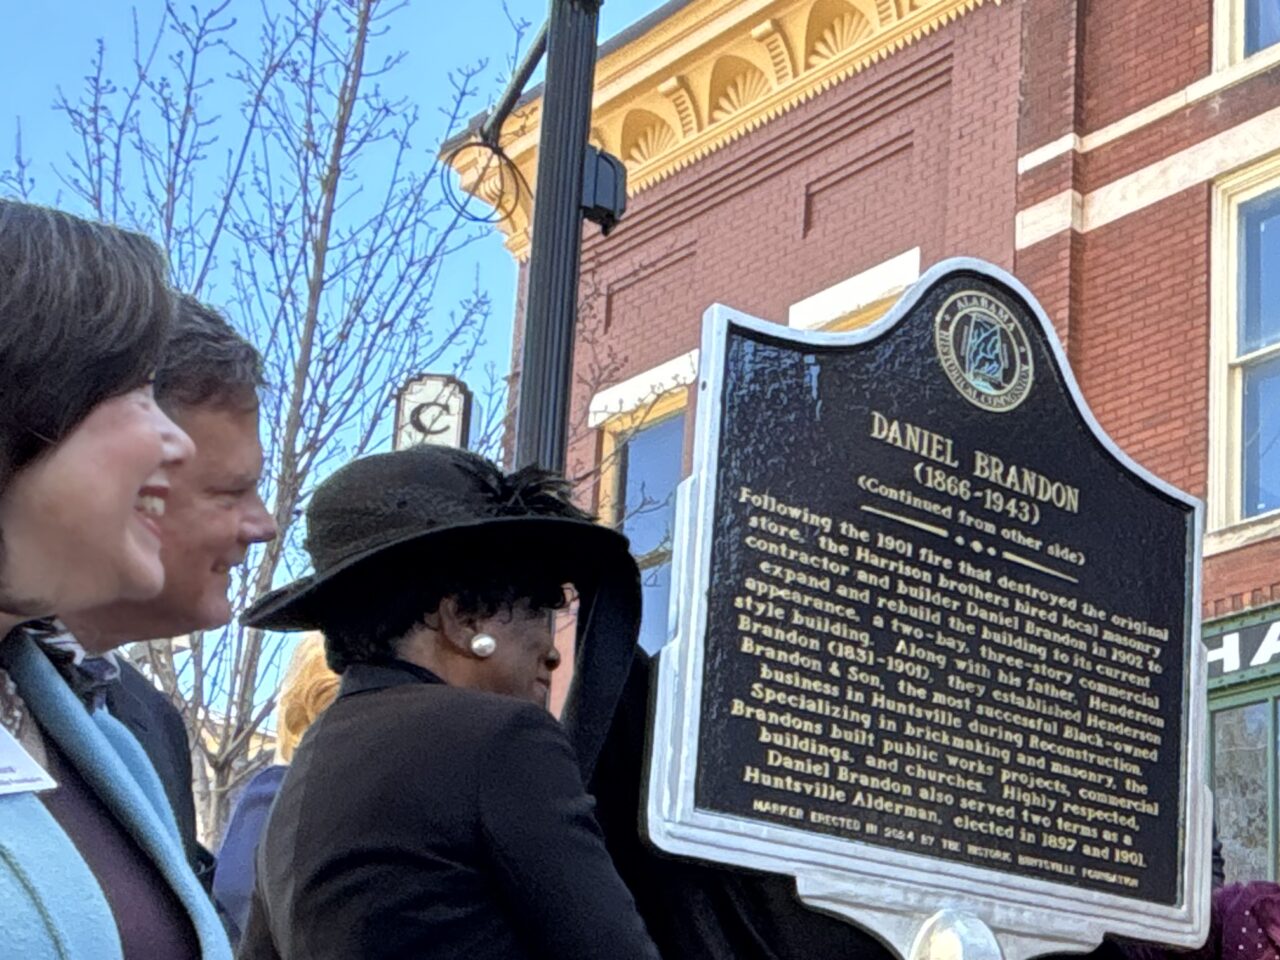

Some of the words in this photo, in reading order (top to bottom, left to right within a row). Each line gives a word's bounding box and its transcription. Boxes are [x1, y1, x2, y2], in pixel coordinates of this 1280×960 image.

[956, 296, 1015, 332] ALABAMA
[410, 402, 450, 435] C
[870, 410, 958, 467] DANIEL
[973, 450, 1078, 512] BRANDON
[857, 474, 952, 519] (Continued
[958, 509, 996, 534] from
[1000, 528, 1042, 550] other
[1047, 543, 1085, 565] side)
[913, 462, 1039, 524] (1866-1943)
[738, 486, 832, 532] Following
[839, 520, 869, 542] the
[876, 532, 912, 556] 1901
[919, 547, 952, 569] fire
[958, 560, 991, 582] that
[997, 575, 1077, 610] destroyed
[1081, 602, 1106, 620] the
[1110, 614, 1168, 641] original
[744, 535, 849, 575] contractor
[856, 569, 889, 589] and
[896, 579, 960, 610] builder
[966, 600, 1018, 629] Daniel
[1024, 619, 1086, 651] Brandon
[1091, 641, 1106, 657] in
[1111, 647, 1142, 668] 1902
[1147, 660, 1161, 673] to
[818, 536, 849, 556] the
[855, 545, 931, 583] Harrison
[937, 572, 1009, 608] brothers
[1014, 598, 1057, 623] hired
[1062, 613, 1098, 636] local
[1101, 629, 1160, 658] masonry
[733, 595, 784, 619] style
[895, 639, 946, 669] Along
[954, 658, 990, 678] with
[997, 668, 1021, 687] his
[1088, 694, 1164, 727] Henderson
[758, 560, 830, 592] expand
[835, 584, 869, 603] and
[876, 596, 940, 624] rebuild
[948, 615, 975, 634] the
[981, 625, 1047, 660] building
[1052, 648, 1069, 663] to
[1073, 653, 1092, 670] its
[1095, 663, 1150, 687] current
[872, 615, 883, 627] a
[979, 644, 1072, 684] three-story
[1078, 677, 1159, 709] commercial
[737, 614, 820, 650] Brandon
[947, 674, 985, 696] they
[991, 689, 1081, 722] established
[1086, 713, 1161, 744] Henderson
[740, 636, 822, 672] Brandon
[828, 661, 840, 677] &
[897, 679, 927, 699] the
[931, 691, 970, 710] most
[975, 704, 1057, 734] successful
[1062, 724, 1157, 761] Black-owned
[759, 663, 839, 696] business
[845, 685, 864, 703] in
[871, 692, 961, 728] Huntsville
[967, 719, 1023, 747] during
[730, 698, 822, 735] Brandons
[829, 723, 874, 746] built
[882, 739, 937, 762] public
[945, 754, 993, 775] works
[1078, 787, 1158, 815] commercial
[750, 682, 871, 728] Specializing
[878, 714, 896, 731] in
[903, 721, 1010, 763] brickmaking
[1016, 752, 1045, 769] and
[1124, 778, 1147, 794] the
[865, 754, 898, 772] and
[1002, 784, 1056, 811] Highly
[743, 766, 845, 802] Huntsville
[953, 814, 1013, 839] elected
[1019, 827, 1035, 843] in
[1041, 832, 1076, 851] 1897
[1082, 844, 1109, 859] and
[752, 799, 803, 819] MARKER
[809, 810, 860, 830] ERECTED
[883, 826, 914, 841] 2024
[766, 749, 829, 778] Daniel
[836, 765, 912, 796] Brandon
[918, 786, 954, 805] also
[959, 797, 1015, 819] served
[1021, 809, 1051, 827] two
[1056, 816, 1097, 838] terms
[1102, 829, 1118, 842] as
[1122, 834, 1132, 845] a
